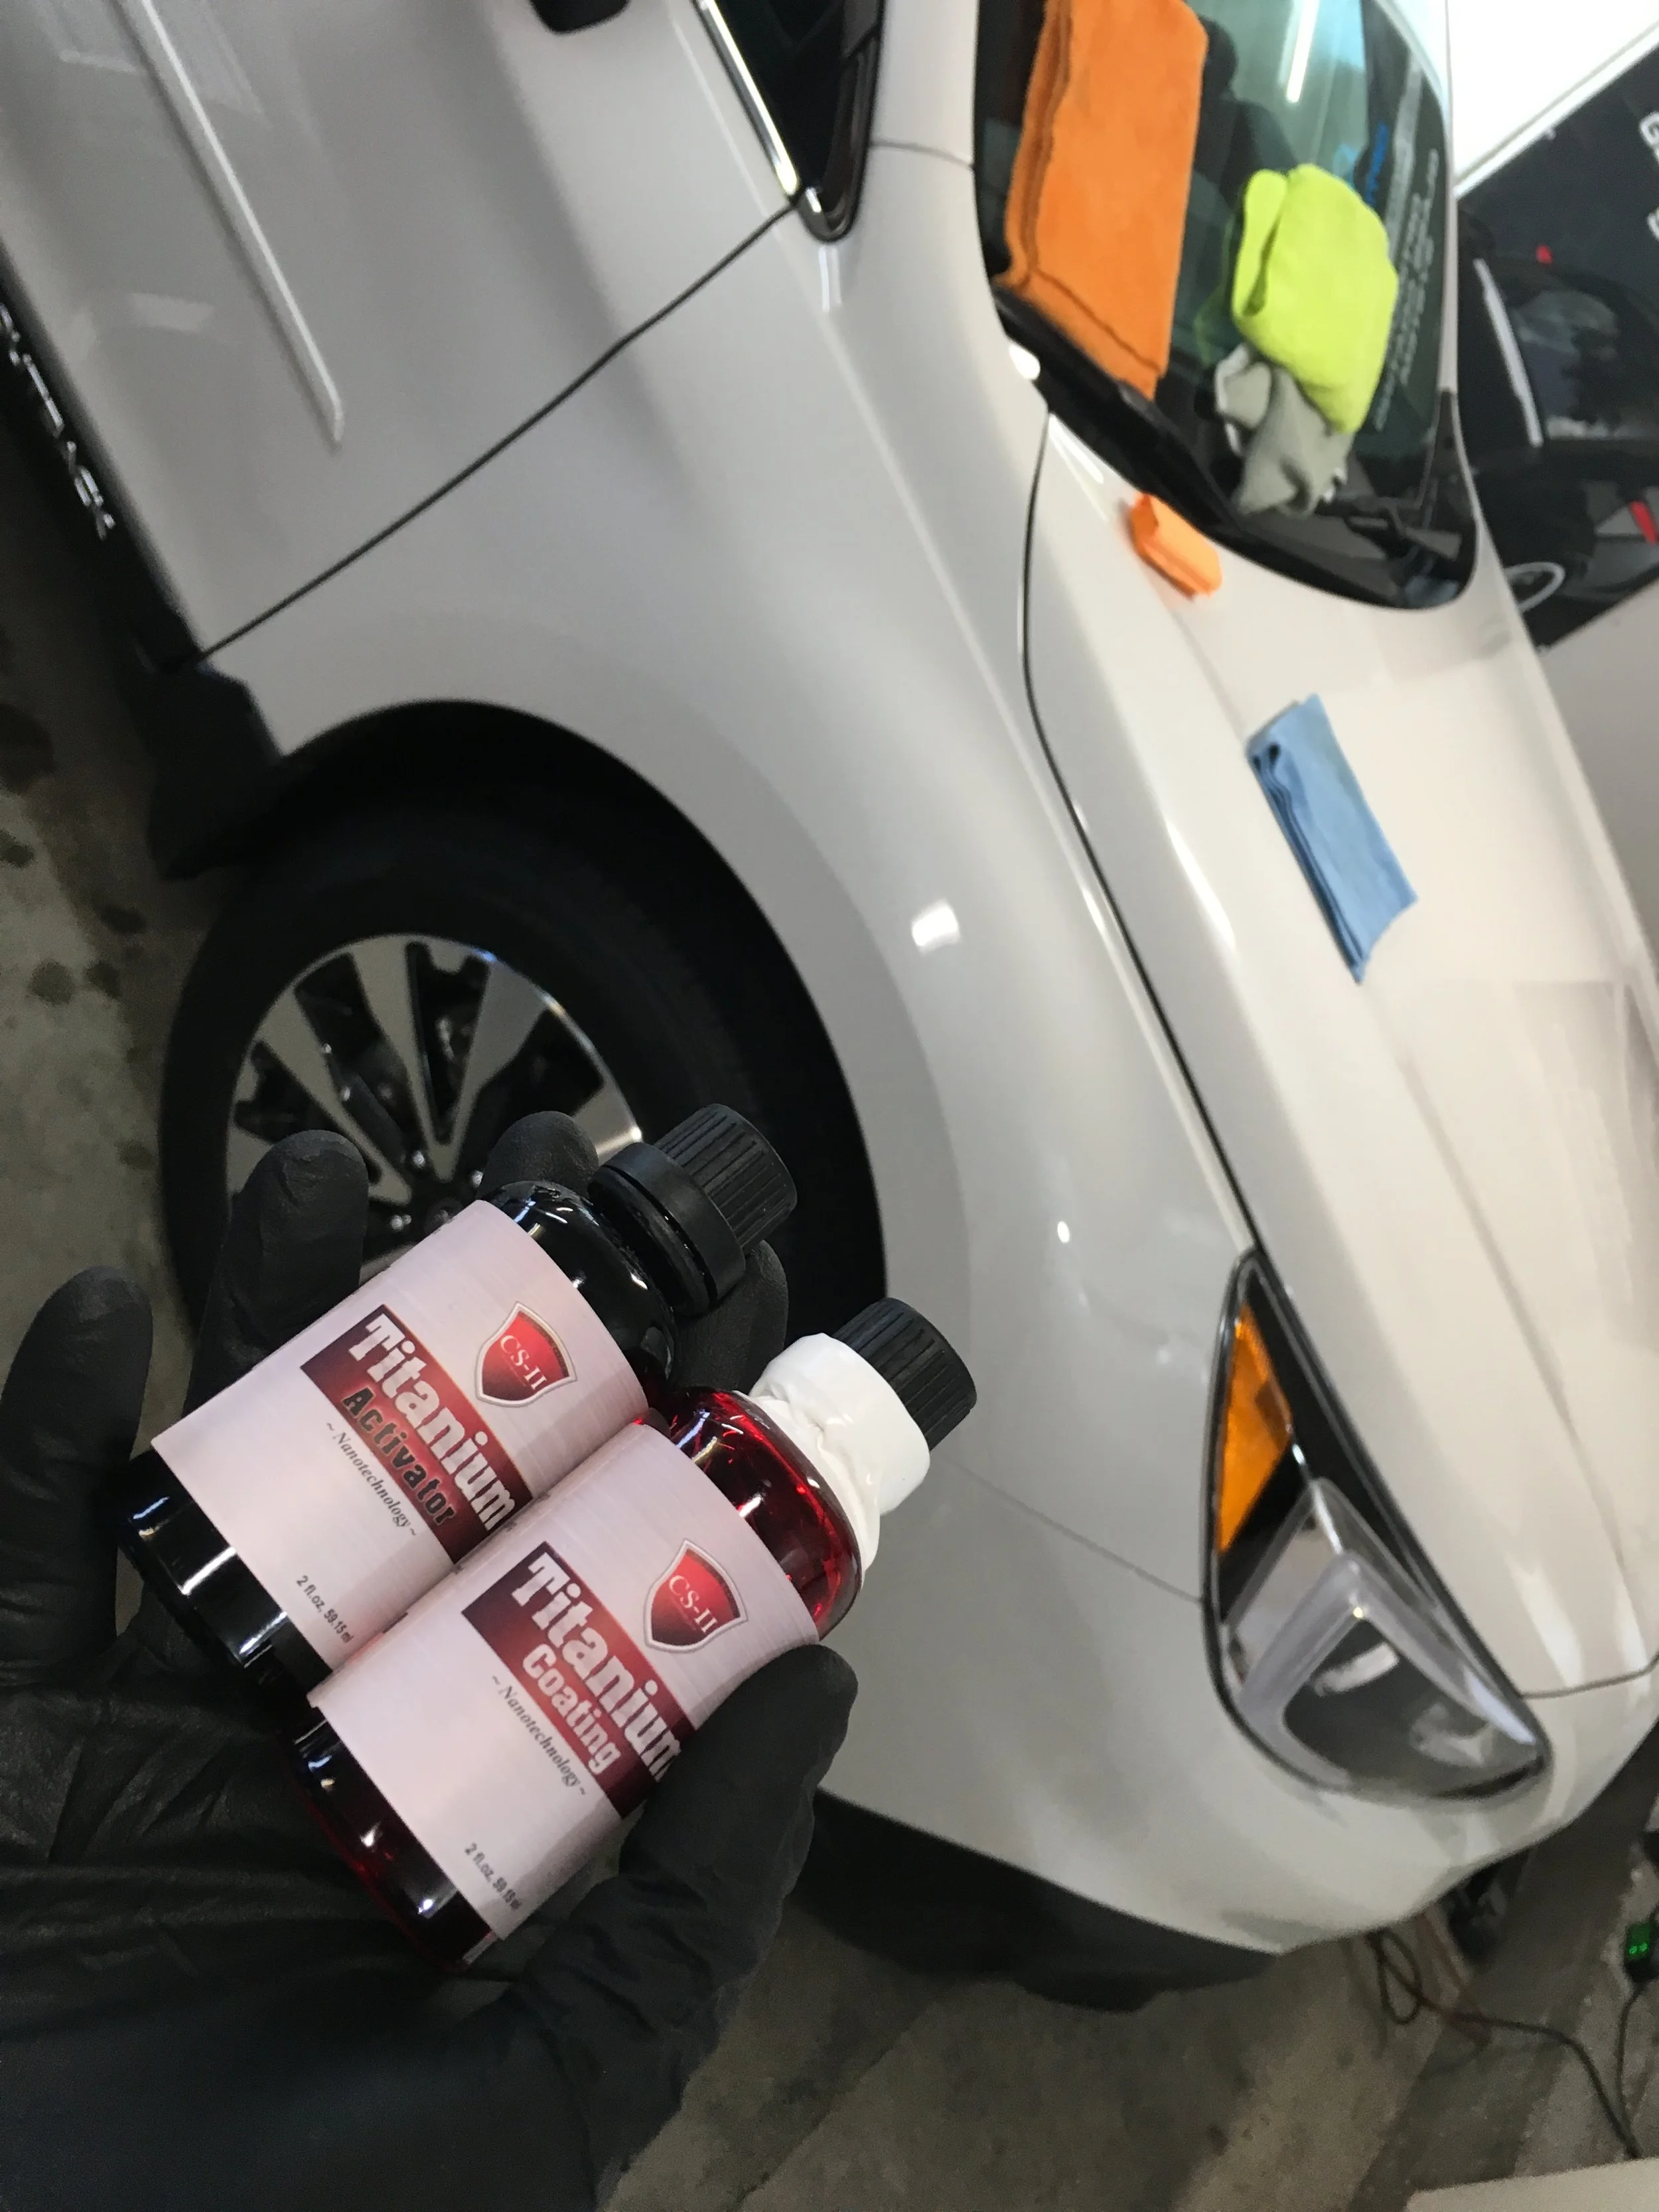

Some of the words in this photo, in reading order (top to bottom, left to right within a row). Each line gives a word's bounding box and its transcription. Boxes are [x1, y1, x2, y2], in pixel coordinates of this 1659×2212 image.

[500, 1334, 547, 1391] CS-II
[340, 1386, 455, 1525] Activator
[348, 1313, 516, 1531] Titanium
[333, 1431, 411, 1528] Nanotechnology
[296, 1574, 309, 1587] 2
[668, 1575, 717, 1634] CS-II
[512, 1550, 682, 1783] Titanium
[522, 1644, 621, 1775] Coating
[499, 1684, 581, 1789] Nanotechnology
